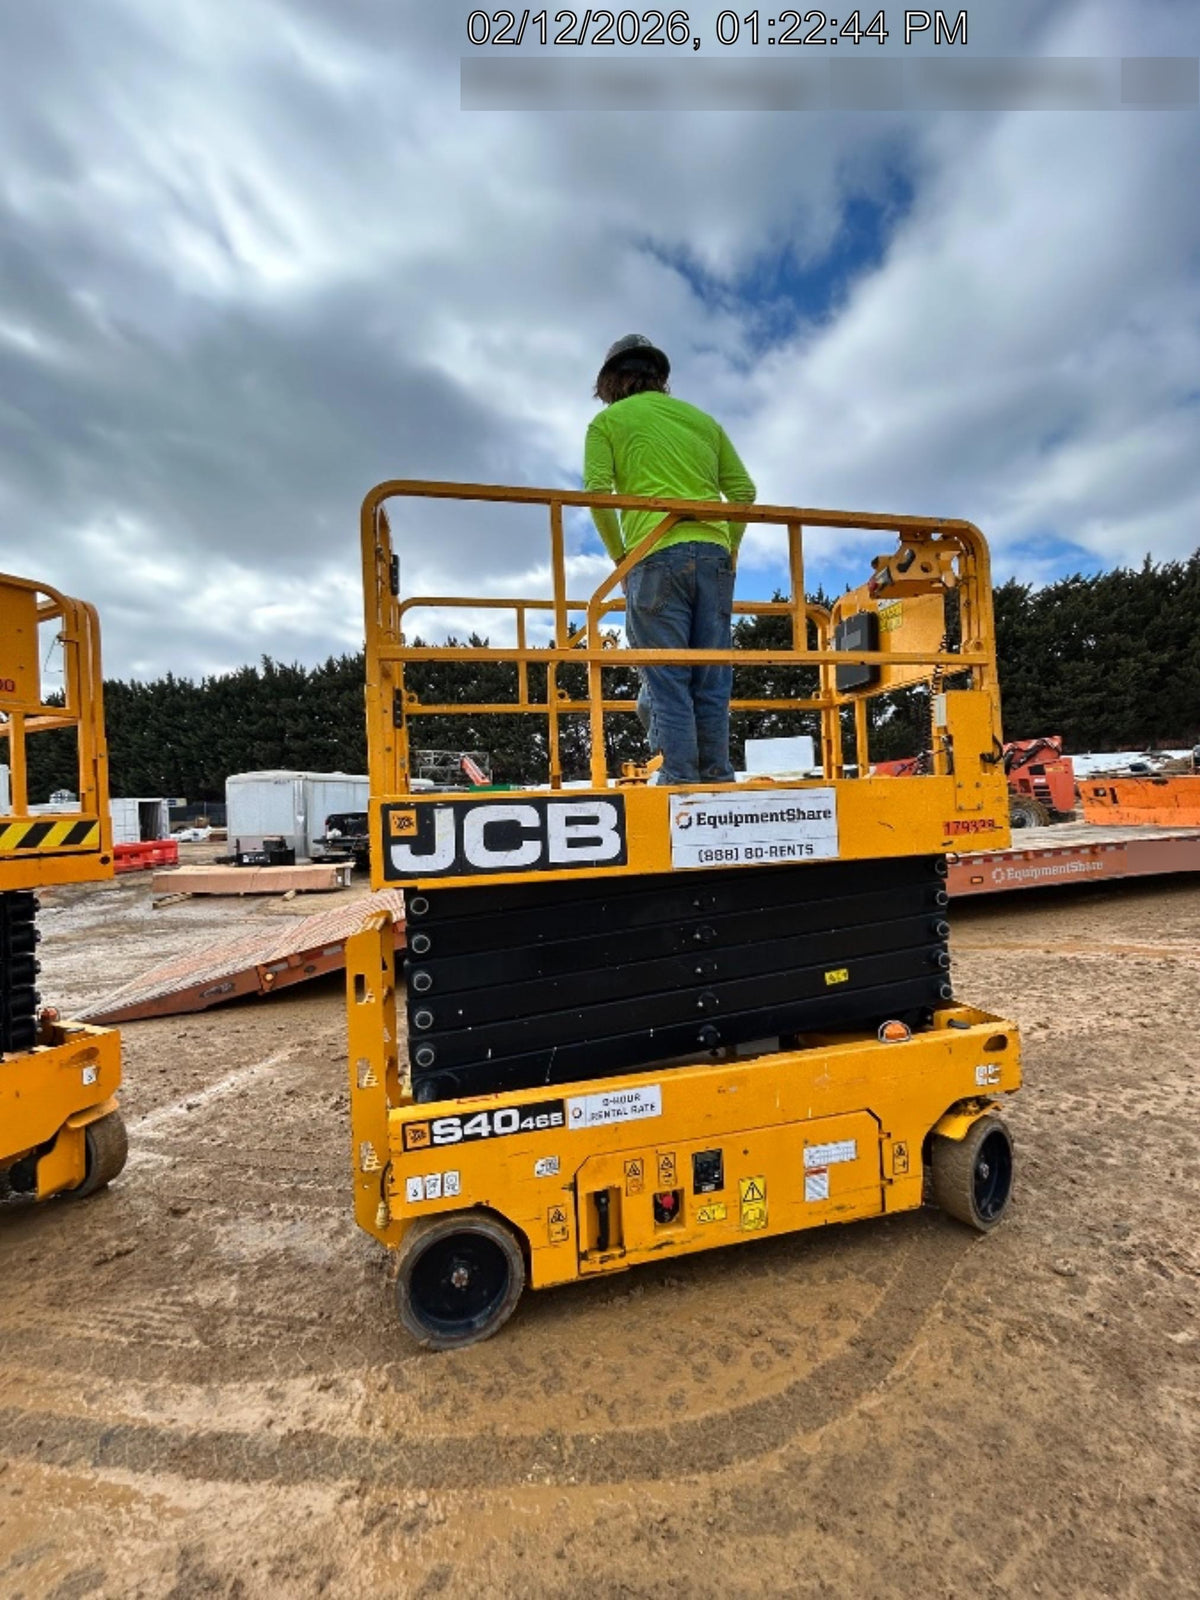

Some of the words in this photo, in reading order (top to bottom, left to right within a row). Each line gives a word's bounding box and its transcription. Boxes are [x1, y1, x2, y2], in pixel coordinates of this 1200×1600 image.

[696, 808, 832, 829] EquipmentShare
[390, 801, 621, 873] JCB
[591, 1107, 628, 1121] RENTAL
[630, 1103, 656, 1114] RATE
